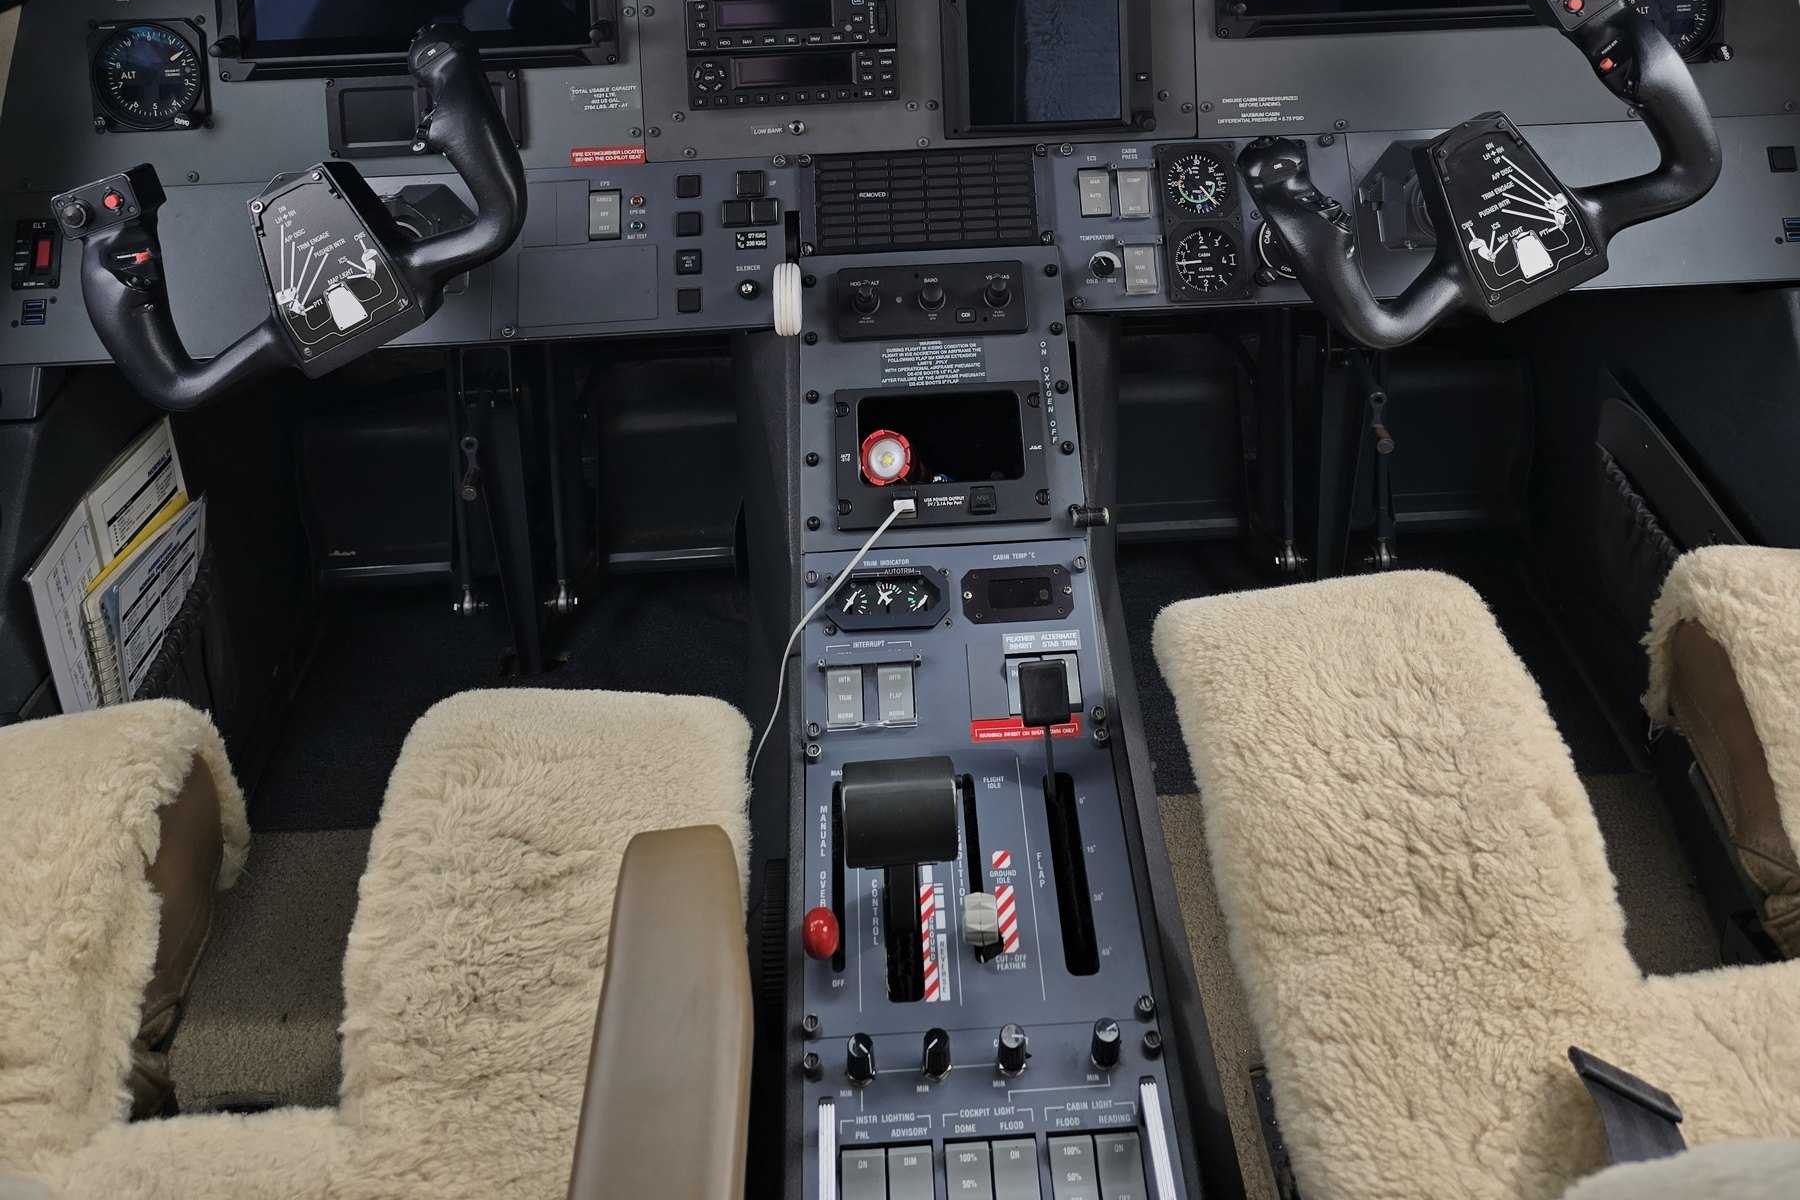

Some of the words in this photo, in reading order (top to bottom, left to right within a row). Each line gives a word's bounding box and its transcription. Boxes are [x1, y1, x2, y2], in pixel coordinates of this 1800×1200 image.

[121, 71, 136, 80] ALT
[767, 127, 783, 135] BANK
[1121, 147, 1137, 155] CABIN
[1500, 165, 1514, 178] DISC
[1480, 190, 1495, 201] TRIM
[1494, 180, 1515, 195] ENGAGE
[1478, 204, 1499, 218] PUSHER
[1497, 197, 1512, 210] INTR
[32, 222, 47, 230] ELT
[1461, 220, 1474, 232] CWS
[1490, 221, 1502, 231] ICS
[292, 227, 306, 238] DISC
[353, 230, 366, 242] CWS
[1079, 233, 1115, 242] TEMPERATURE
[1497, 232, 1509, 244] MAP
[1508, 225, 1523, 238] LIGHT
[1539, 228, 1551, 238] PTT
[296, 241, 311, 252] TRIM
[309, 230, 331, 245] ENGAGE
[313, 243, 333, 259] PUSHER
[331, 237, 346, 250] INTR
[735, 264, 761, 272] SILENCER
[1198, 265, 1214, 273] CLIMB
[327, 274, 339, 286] MAP
[338, 267, 354, 280] LIGHT
[924, 276, 939, 284] BARO
[1086, 278, 1099, 286] COLD
[1106, 277, 1117, 285] HOT
[871, 279, 880, 287] ALT
[312, 298, 324, 308] PTT
[961, 310, 971, 318] CDI
[1040, 341, 1048, 356] ON
[1043, 365, 1055, 414] OXYGEN
[1050, 419, 1059, 445] OFF
[992, 553, 1010, 561] CABIN
[1012, 552, 1027, 560] TEMP
[880, 558, 910, 567] INDICATOR
[884, 567, 915, 575] AUTOTRIM
[1006, 634, 1036, 643] FEATHER
[1040, 631, 1078, 641] ALTERNATE
[853, 640, 885, 649] INTERRUPT
[1041, 640, 1059, 648] STAB
[1059, 639, 1077, 647] TRIM
[983, 775, 1004, 784] FLIGHT
[987, 782, 1001, 790] IDLE
[819, 805, 828, 857] MANUAL
[990, 869, 1017, 878] GROUND
[1036, 851, 1045, 888] FLAP
[996, 876, 1011, 884] IDLE
[871, 877, 881, 946] CONTROL
[995, 954, 1011, 963] CUT
[1014, 953, 1027, 961] OFF
[997, 961, 1027, 970] FEATHER
[832, 979, 845, 988] OFF
[1086, 1073, 1099, 1082] MIN
[993, 1079, 1006, 1087] MIN
[839, 1089, 853, 1097] MIN
[916, 1084, 929, 1093] MIN
[1066, 1101, 1089, 1111] CABIN
[1090, 1099, 1112, 1109] LIGHT
[959, 1107, 991, 1119] COCKPIT
[993, 1105, 1015, 1116] LIGHT
[856, 1115, 879, 1126] INSTR
[881, 1113, 915, 1124] LIGHTING
[1055, 1117, 1080, 1127] FLOOD
[1098, 1114, 1131, 1125] READING
[954, 1123, 976, 1133] DOME
[999, 1121, 1024, 1131] FLOOD
[855, 1131, 870, 1140] PNL
[890, 1127, 928, 1138] ADVISORY
[1063, 1145, 1082, 1156] 100%
[1114, 1143, 1125, 1153] ON
[960, 1152, 978, 1164] 100%
[1009, 1150, 1021, 1161] ON
[857, 1159, 869, 1169] ON
[904, 1156, 918, 1167] DIM
[1066, 1171, 1083, 1183] 50%
[962, 1179, 978, 1190] 50%
